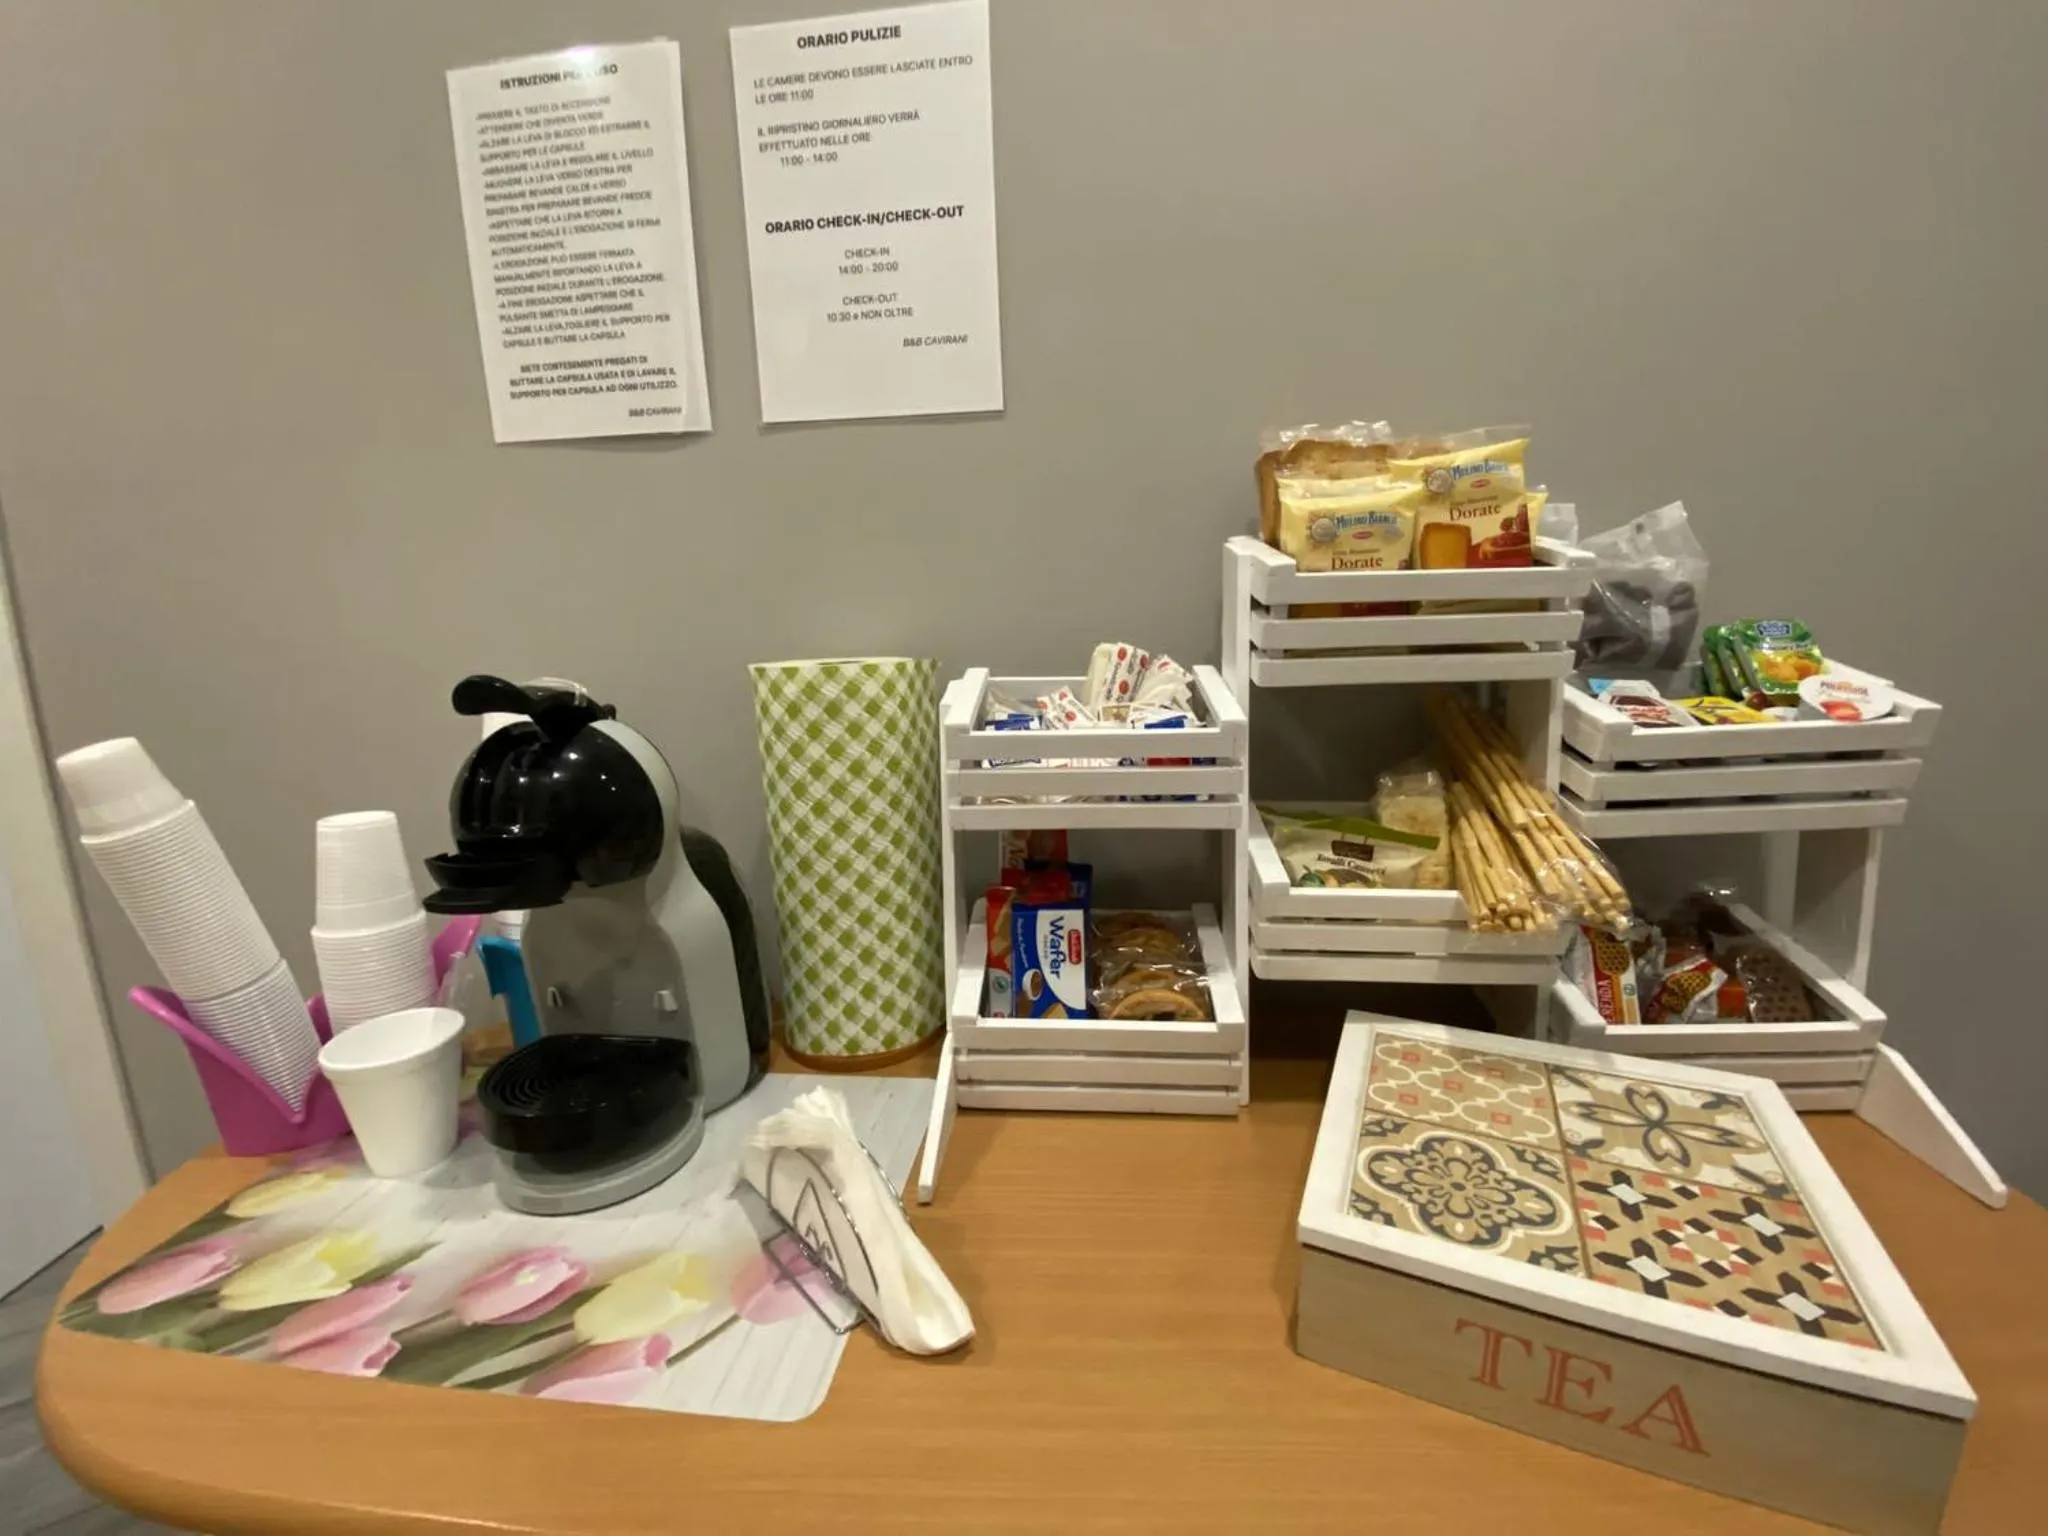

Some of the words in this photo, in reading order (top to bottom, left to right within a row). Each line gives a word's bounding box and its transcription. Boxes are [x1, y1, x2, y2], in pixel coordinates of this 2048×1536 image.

[797, 32, 848, 49] ORARIO
[851, 25, 902, 43] PULIZIE
[767, 74, 806, 87] CAMERE
[809, 69, 850, 82] DEVONO
[852, 65, 888, 78] ESSERE
[890, 59, 935, 73] LASCIATE
[939, 55, 973, 68] ENTRO
[500, 72, 561, 89] ISTRUZIONI
[768, 92, 788, 103] ORE
[768, 121, 820, 136] RIPRISTINO
[822, 113, 886, 130] GIORNALIERO
[759, 137, 818, 152] EFFETTUATO
[820, 134, 849, 146] NELLE
[852, 132, 871, 143] ORE
[621, 148, 654, 159] LIVELLO
[584, 167, 614, 177] DESTRA
[616, 165, 632, 174] PER
[765, 219, 814, 234] ORARIO
[816, 205, 964, 229] CHECK-IN/CHECK-OUT
[845, 247, 891, 259] CHECK-IN
[842, 293, 898, 306] CHECK-OUT
[861, 310, 882, 320] NON
[884, 308, 913, 318] OLTRE
[903, 338, 923, 347] B&B
[924, 335, 968, 346] CAVIRANI
[542, 360, 604, 371] CORTESEMENTE
[605, 357, 638, 366] PREGATI
[510, 377, 544, 386] BUTTARE
[557, 374, 592, 383] CAPSULA
[594, 372, 619, 380] USATA
[637, 368, 667, 377] LAVARE
[510, 390, 551, 399] SUPPORTO
[568, 386, 604, 395] CAPSULA
[1449, 503, 1502, 521] Dorate
[1331, 556, 1384, 570] Dorate
[1047, 915, 1066, 979] Wafer
[1454, 1317, 1712, 1458] TEA
